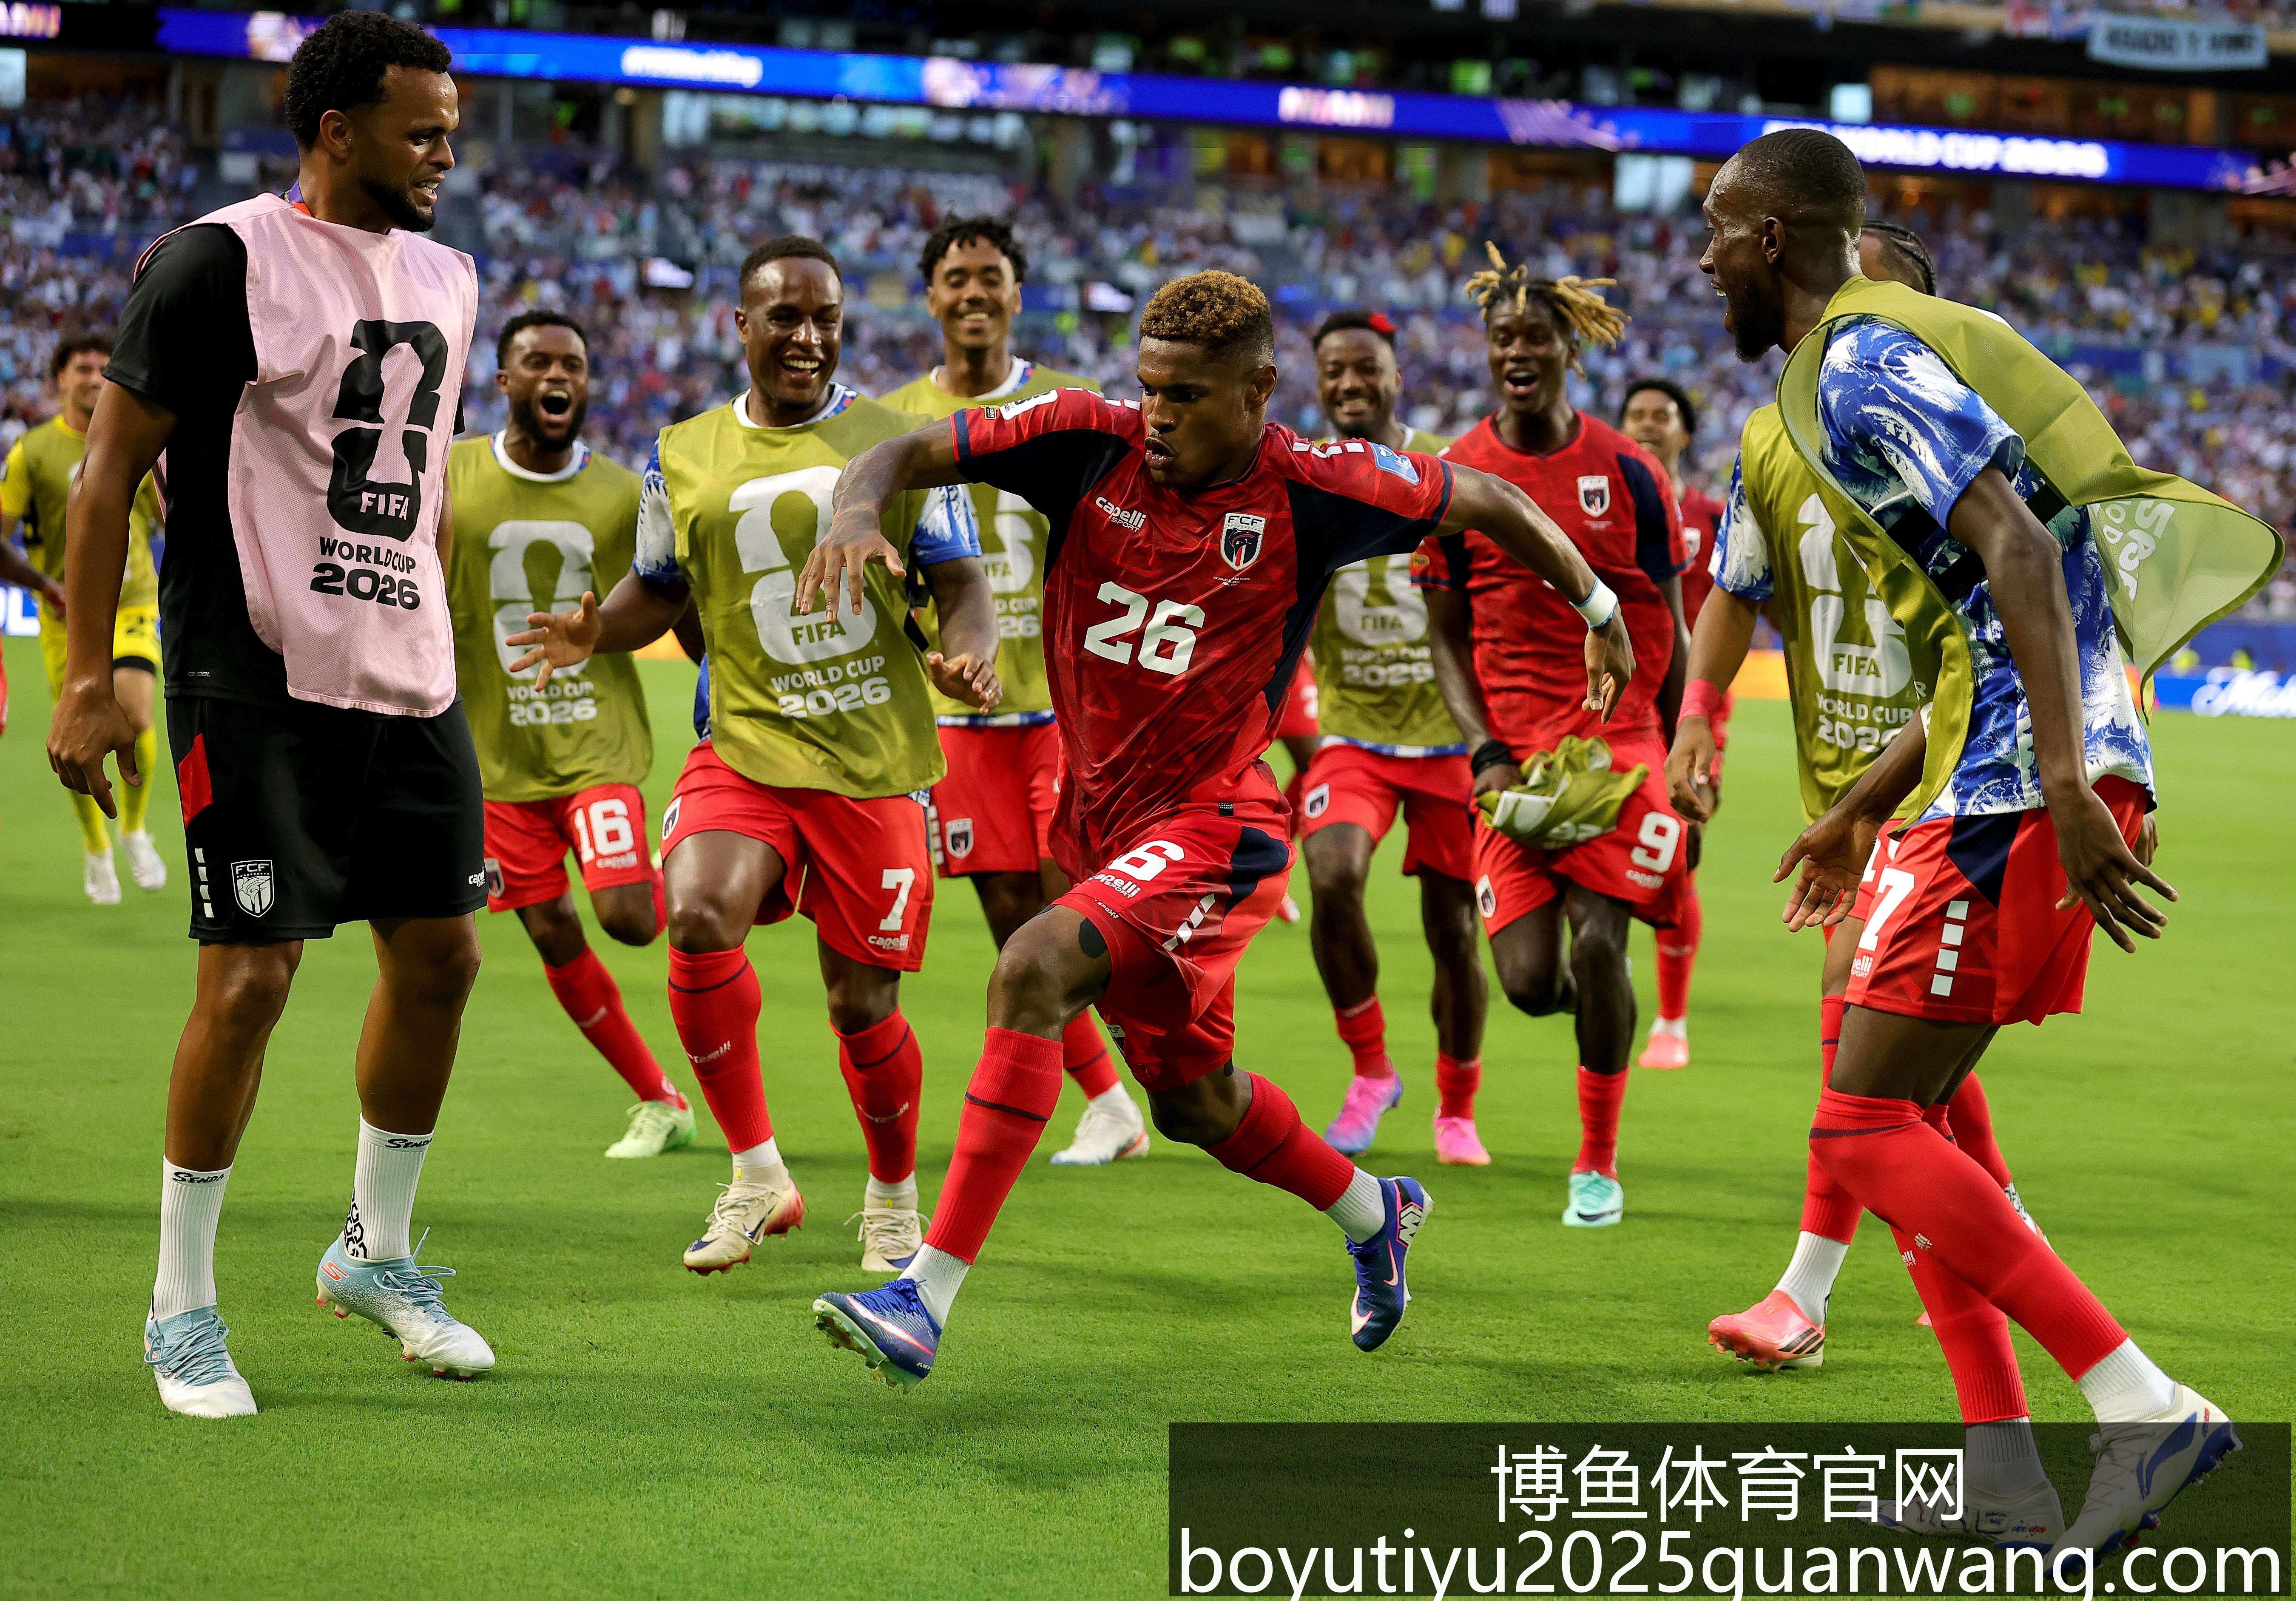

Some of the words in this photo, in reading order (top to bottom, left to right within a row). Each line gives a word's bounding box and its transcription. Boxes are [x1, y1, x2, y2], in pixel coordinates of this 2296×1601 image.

[360, 491, 409, 521] FIFA
[1095, 497, 1146, 529] capelli
[1228, 515, 1262, 526] FCF
[1111, 517, 1140, 533] SPORT
[319, 536, 392, 566] WORLD
[391, 552, 416, 574] CUP
[984, 562, 1013, 578] IFA
[310, 562, 421, 610] 2026
[792, 621, 846, 645] FIFA
[999, 614, 1041, 638] 26
[1084, 581, 1206, 675] 26
[770, 665, 844, 693] WORLD
[846, 654, 886, 679] CUP
[1833, 653, 1881, 678] FIFA
[509, 697, 598, 726] 2026
[777, 676, 892, 718] 2026
[1872, 705, 1914, 724] CUP
[574, 798, 635, 864] 16
[1631, 812, 1680, 873] 9
[235, 863, 269, 874] FCF
[879, 868, 915, 931] 7
[1858, 867, 1915, 951] 7
[867, 934, 909, 951] capelli
[172, 1171, 224, 1184] SENDA
